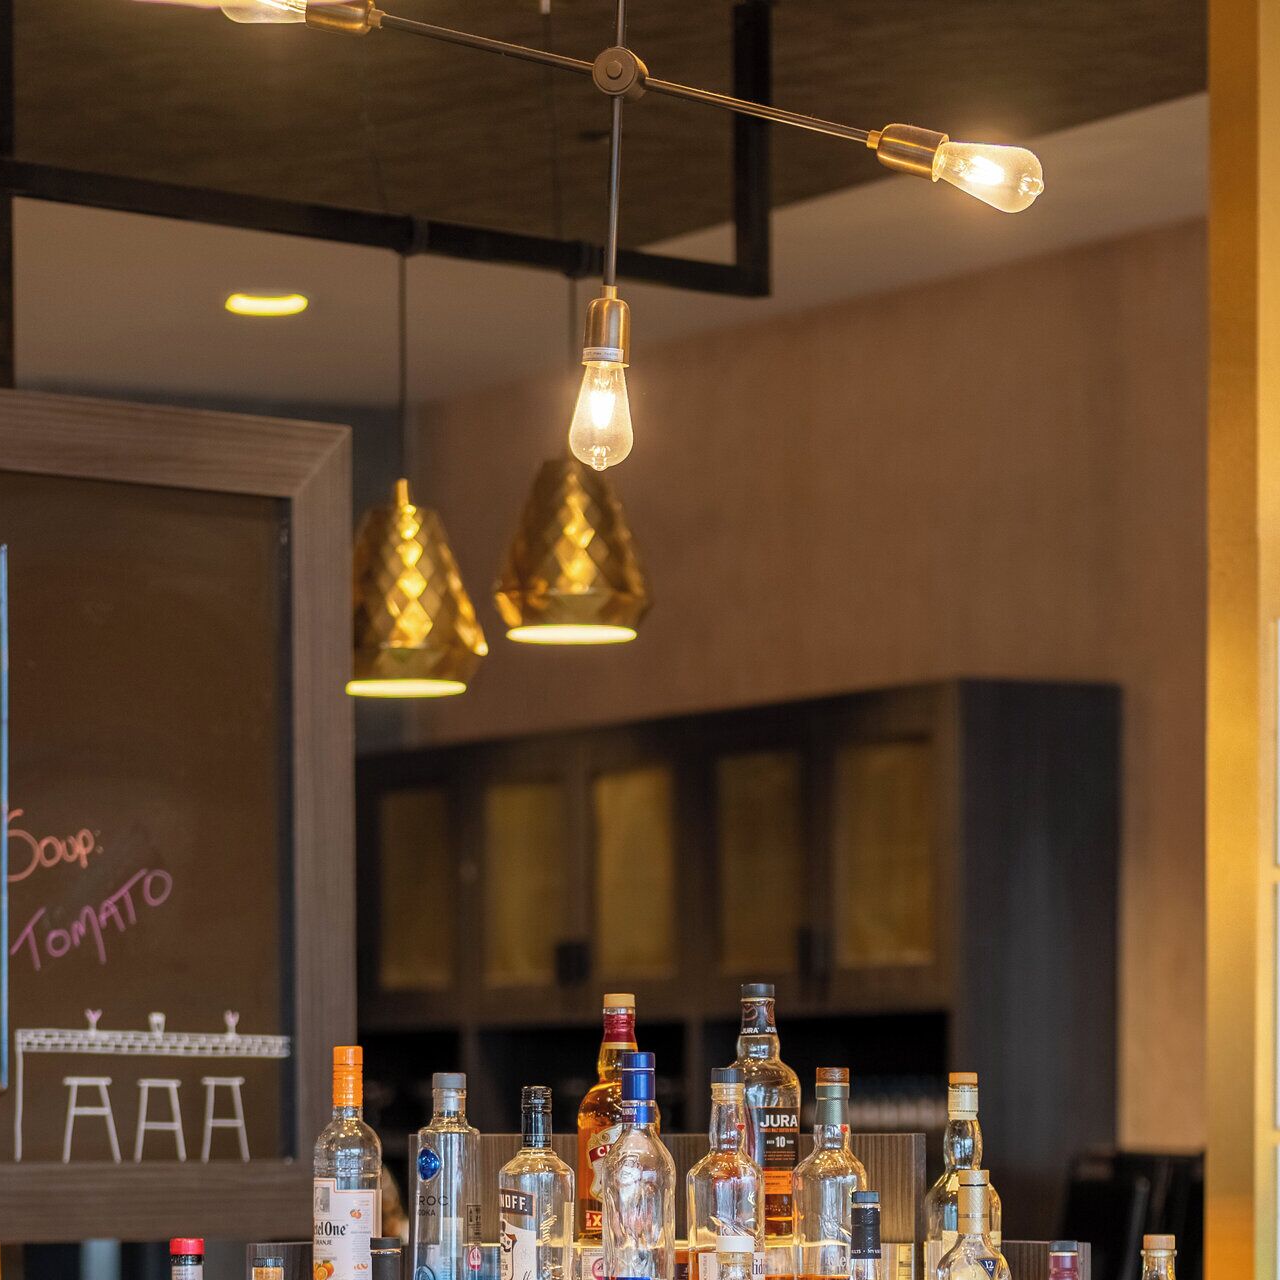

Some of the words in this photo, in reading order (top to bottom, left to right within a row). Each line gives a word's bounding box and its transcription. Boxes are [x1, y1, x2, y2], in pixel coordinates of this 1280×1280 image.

[9, 867, 173, 971] TOMATO
[760, 1114, 799, 1128] JURA
[775, 1136, 786, 1148] 10
[984, 1259, 995, 1270] 12
